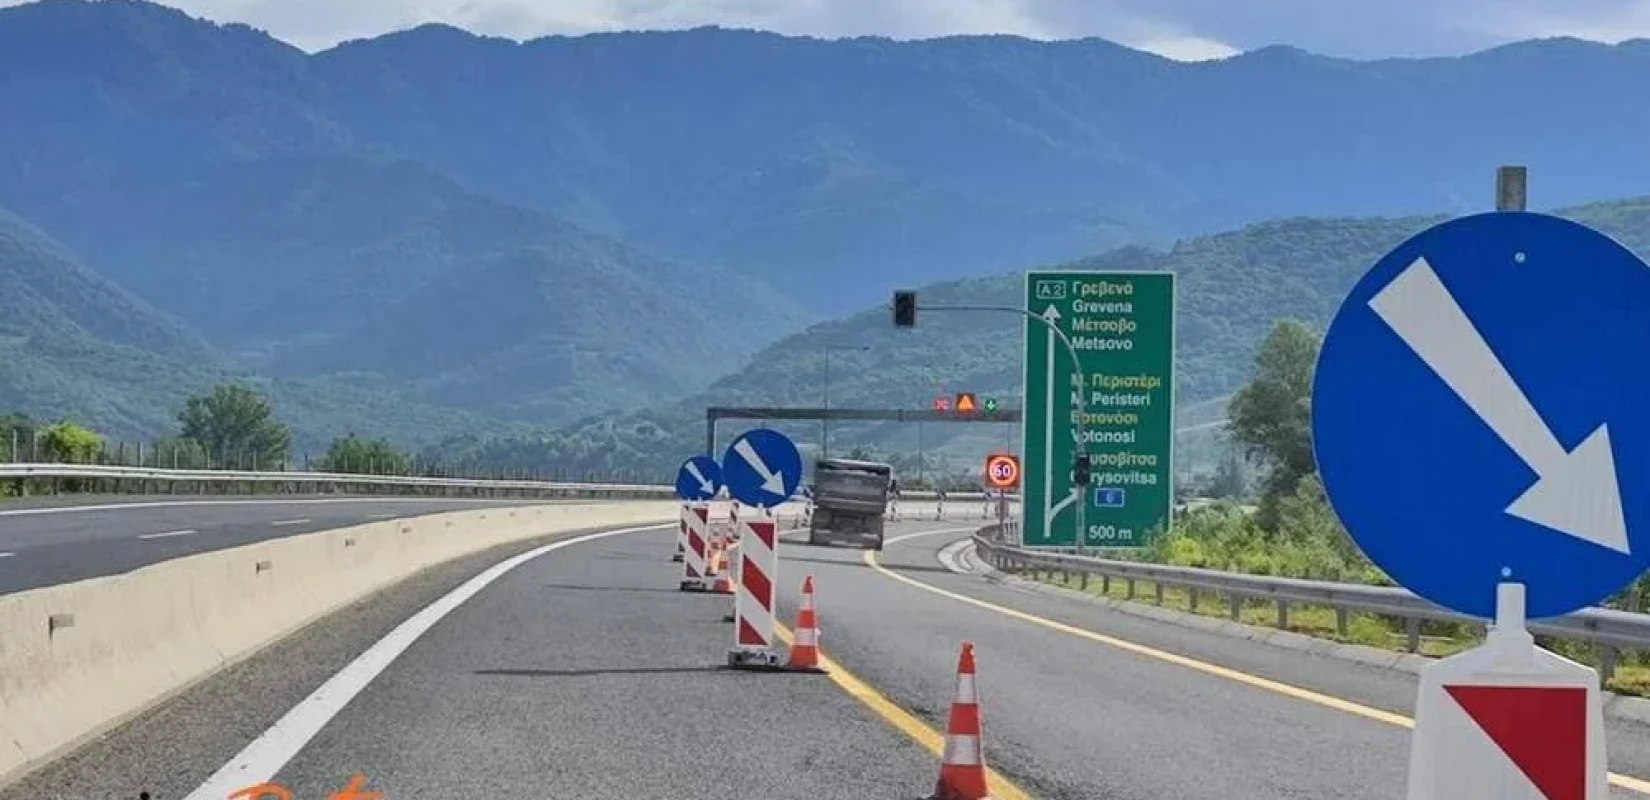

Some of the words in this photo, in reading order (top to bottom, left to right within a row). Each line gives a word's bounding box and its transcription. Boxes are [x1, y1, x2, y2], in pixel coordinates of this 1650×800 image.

[1073, 281, 1133, 297] Γρεβενά
[1072, 299, 1133, 313] Grevena
[1072, 317, 1137, 335] Μέτσοβο
[1072, 336, 1133, 350] Metsovo
[1091, 372, 1161, 389] Περιστέρι
[1091, 391, 1151, 406] Peristeri
[1070, 428, 1135, 443] Votonosi
[1070, 450, 1158, 467] υσοβίτσα
[994, 464, 1011, 477] 60
[1088, 525, 1115, 539] 500
[1118, 528, 1133, 540] m
